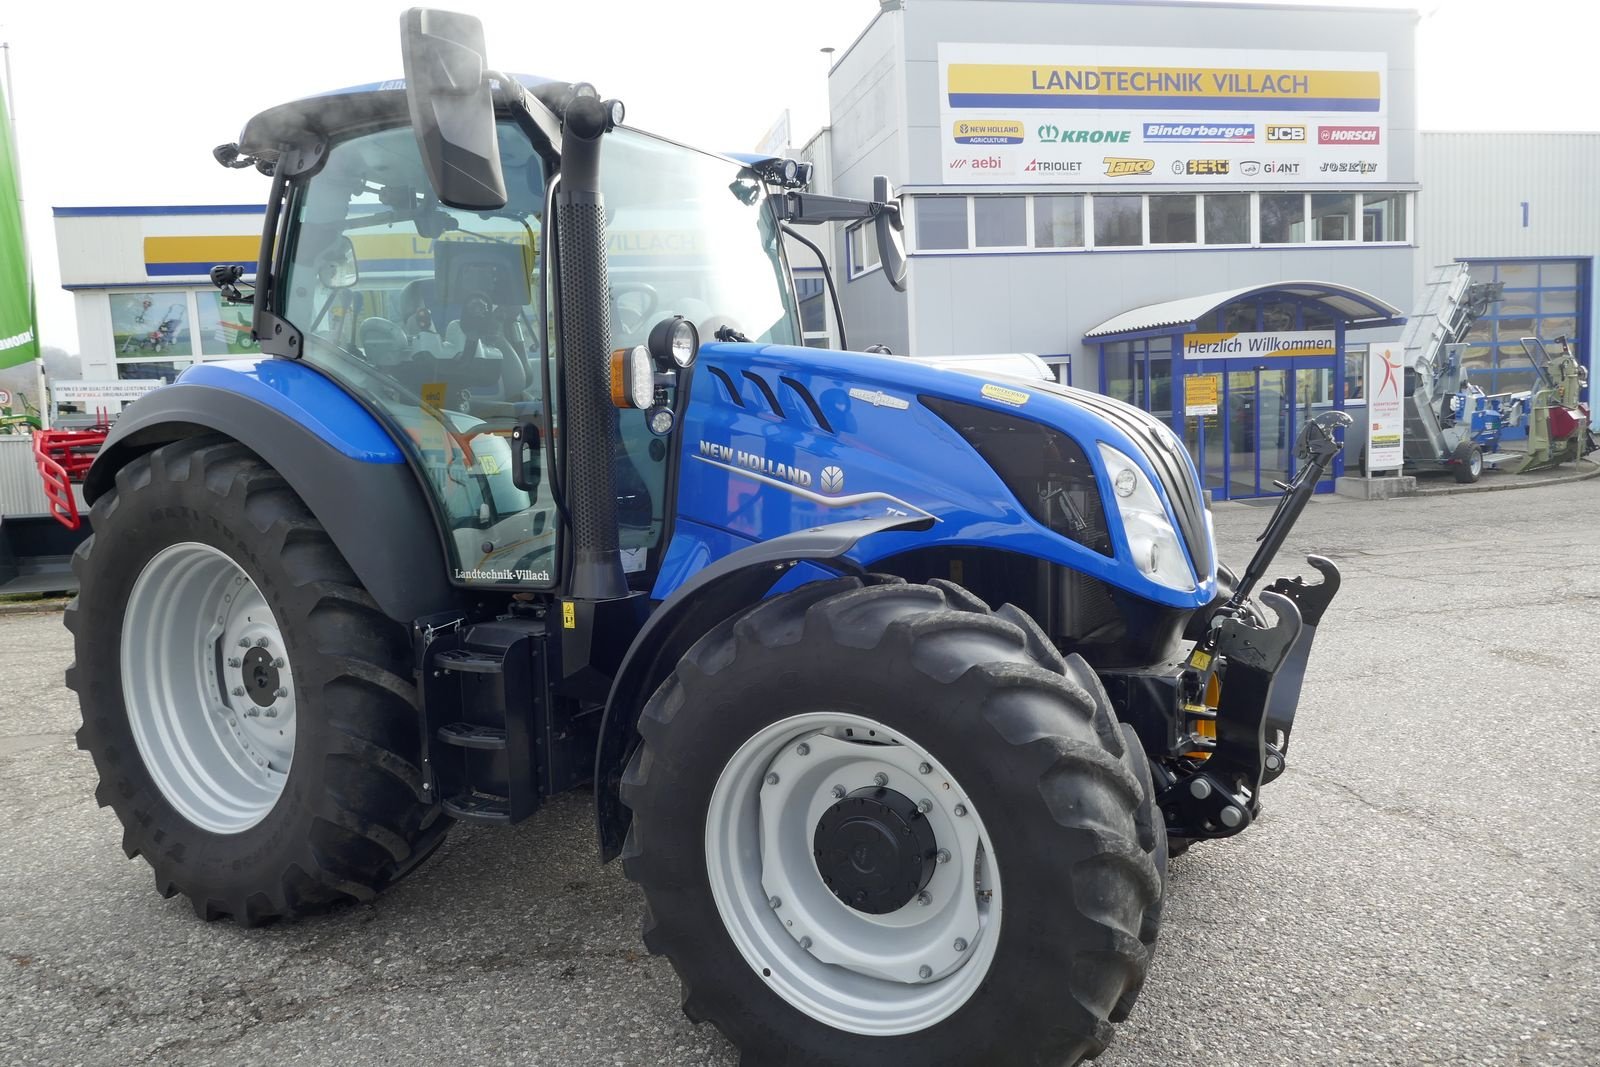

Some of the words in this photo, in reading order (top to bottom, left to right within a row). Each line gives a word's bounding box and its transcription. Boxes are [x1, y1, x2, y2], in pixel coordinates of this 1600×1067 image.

[1031, 70, 1203, 92] LANDTECHNIK
[1212, 72, 1309, 94] VILLACH
[1061, 130, 1131, 143] KRONE
[1147, 125, 1252, 138] Binderberger
[1267, 127, 1305, 140] JCB
[1330, 130, 1377, 140] HORSCH
[971, 156, 1002, 169] aebi
[1036, 161, 1082, 171] TRIOLIET
[1103, 157, 1155, 175] Tanco
[1319, 160, 1378, 174] JOSKIN
[1187, 338, 1242, 354] Herzlich
[1248, 336, 1332, 352] Willkommen
[699, 439, 734, 461] NEW
[737, 450, 812, 487] HOLLAND
[454, 568, 550, 581] Landtechnik-Villach
